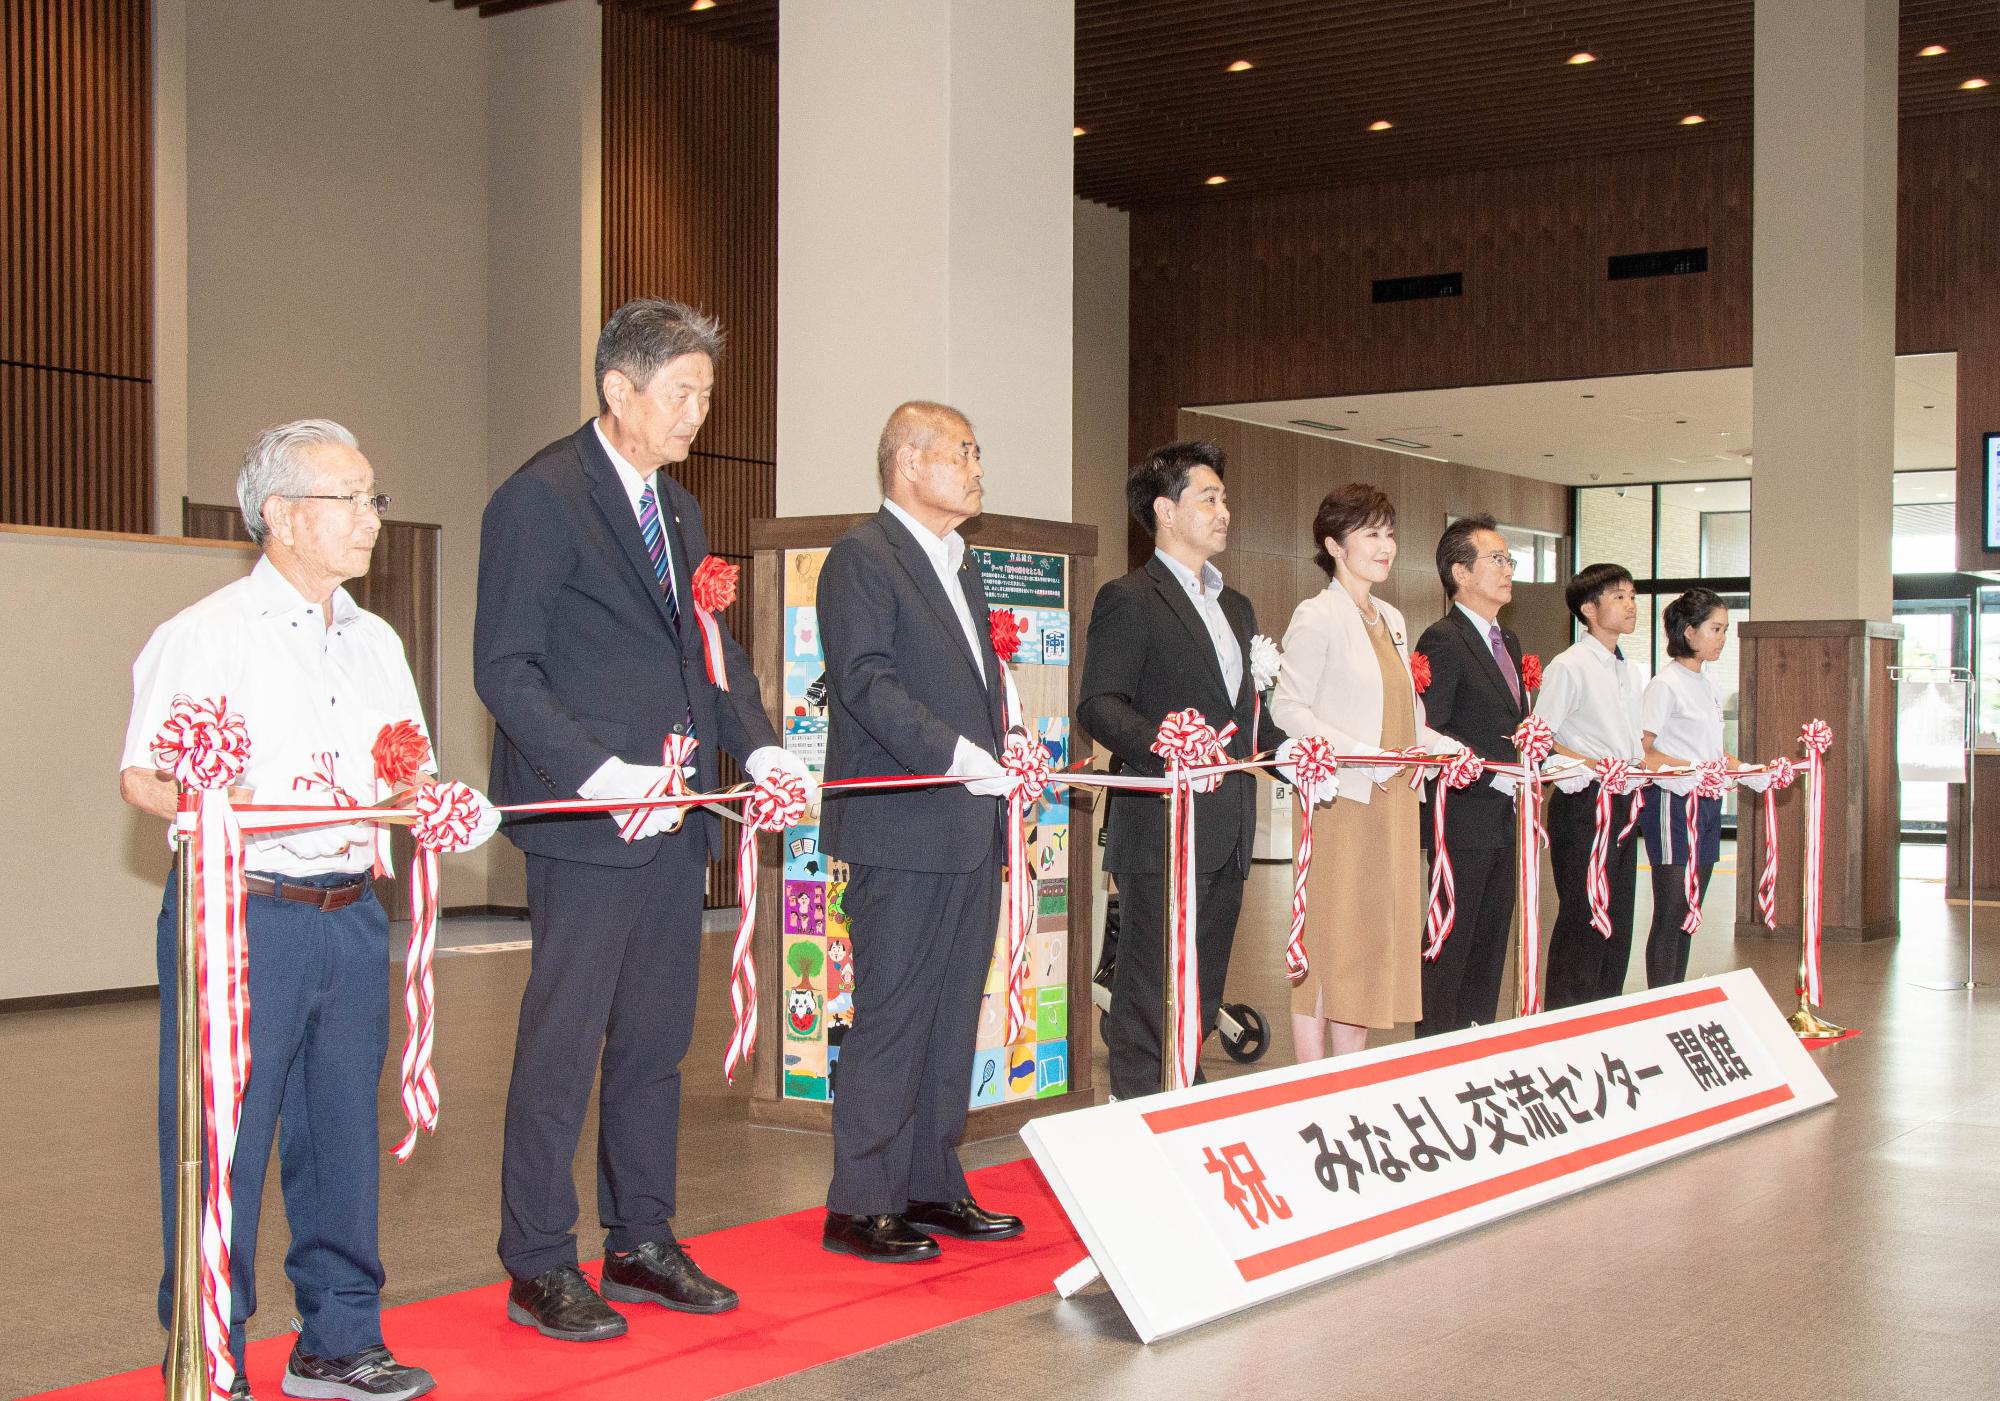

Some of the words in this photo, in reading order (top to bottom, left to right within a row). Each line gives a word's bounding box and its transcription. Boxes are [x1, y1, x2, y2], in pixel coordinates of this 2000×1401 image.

[1202, 1141, 1293, 1230] 祝
[1298, 1051, 1664, 1194] みなよし交流センター
[1665, 1021, 1752, 1091] 開館
